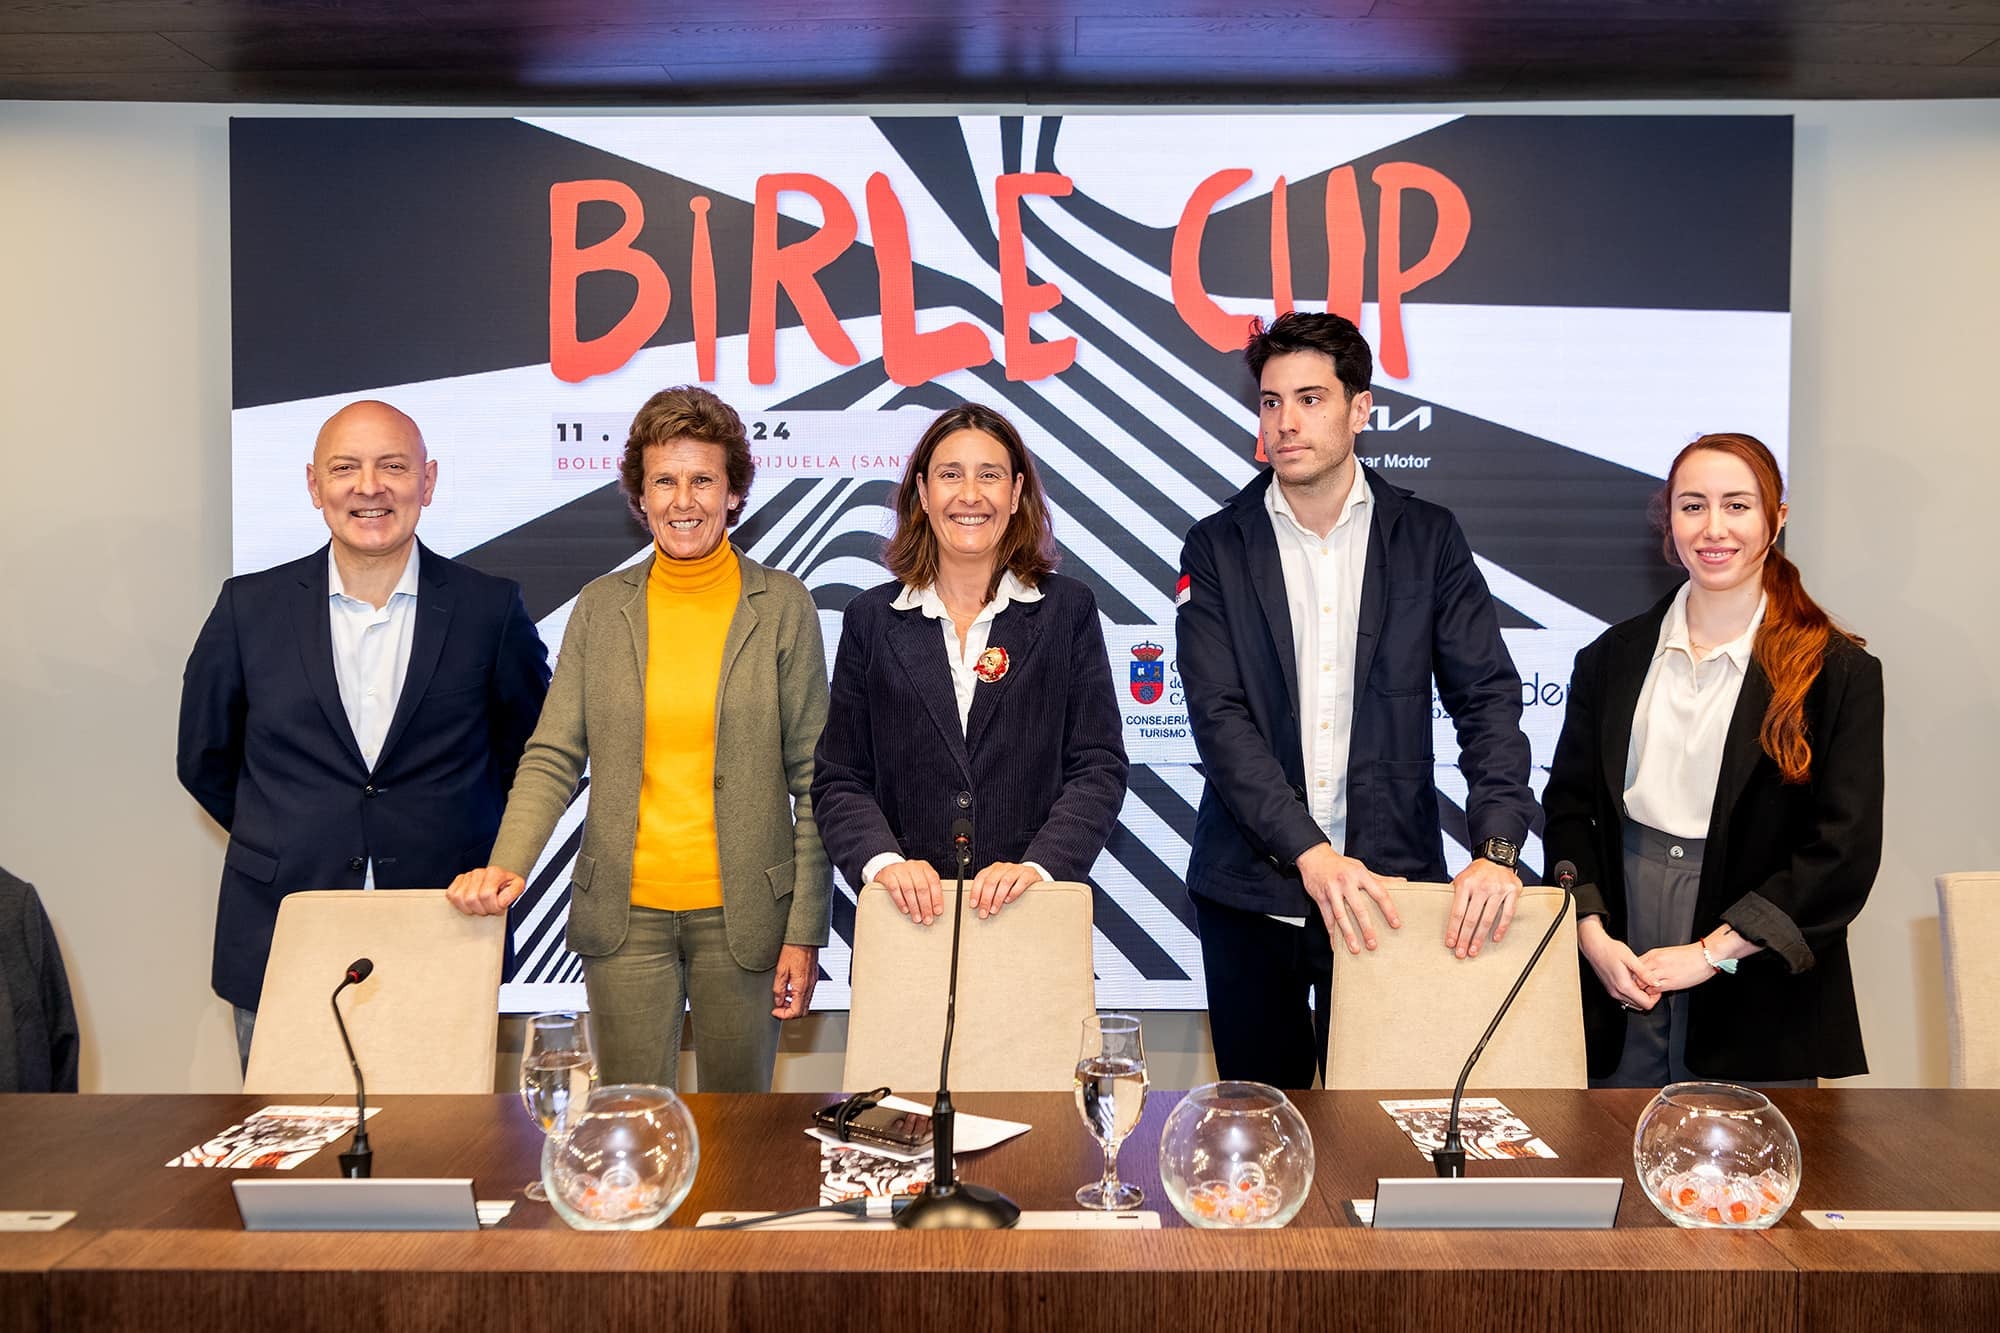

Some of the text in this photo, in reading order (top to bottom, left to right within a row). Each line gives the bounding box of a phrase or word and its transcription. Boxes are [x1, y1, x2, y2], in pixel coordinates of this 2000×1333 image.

[548, 161, 1471, 386] BIRLE CUP
[557, 423, 583, 442] 11
[745, 421, 790, 440] 24
[751, 455, 841, 468] RIJUELA
[1384, 455, 1431, 468] Motor
[1140, 728, 1187, 738] TURISMO
